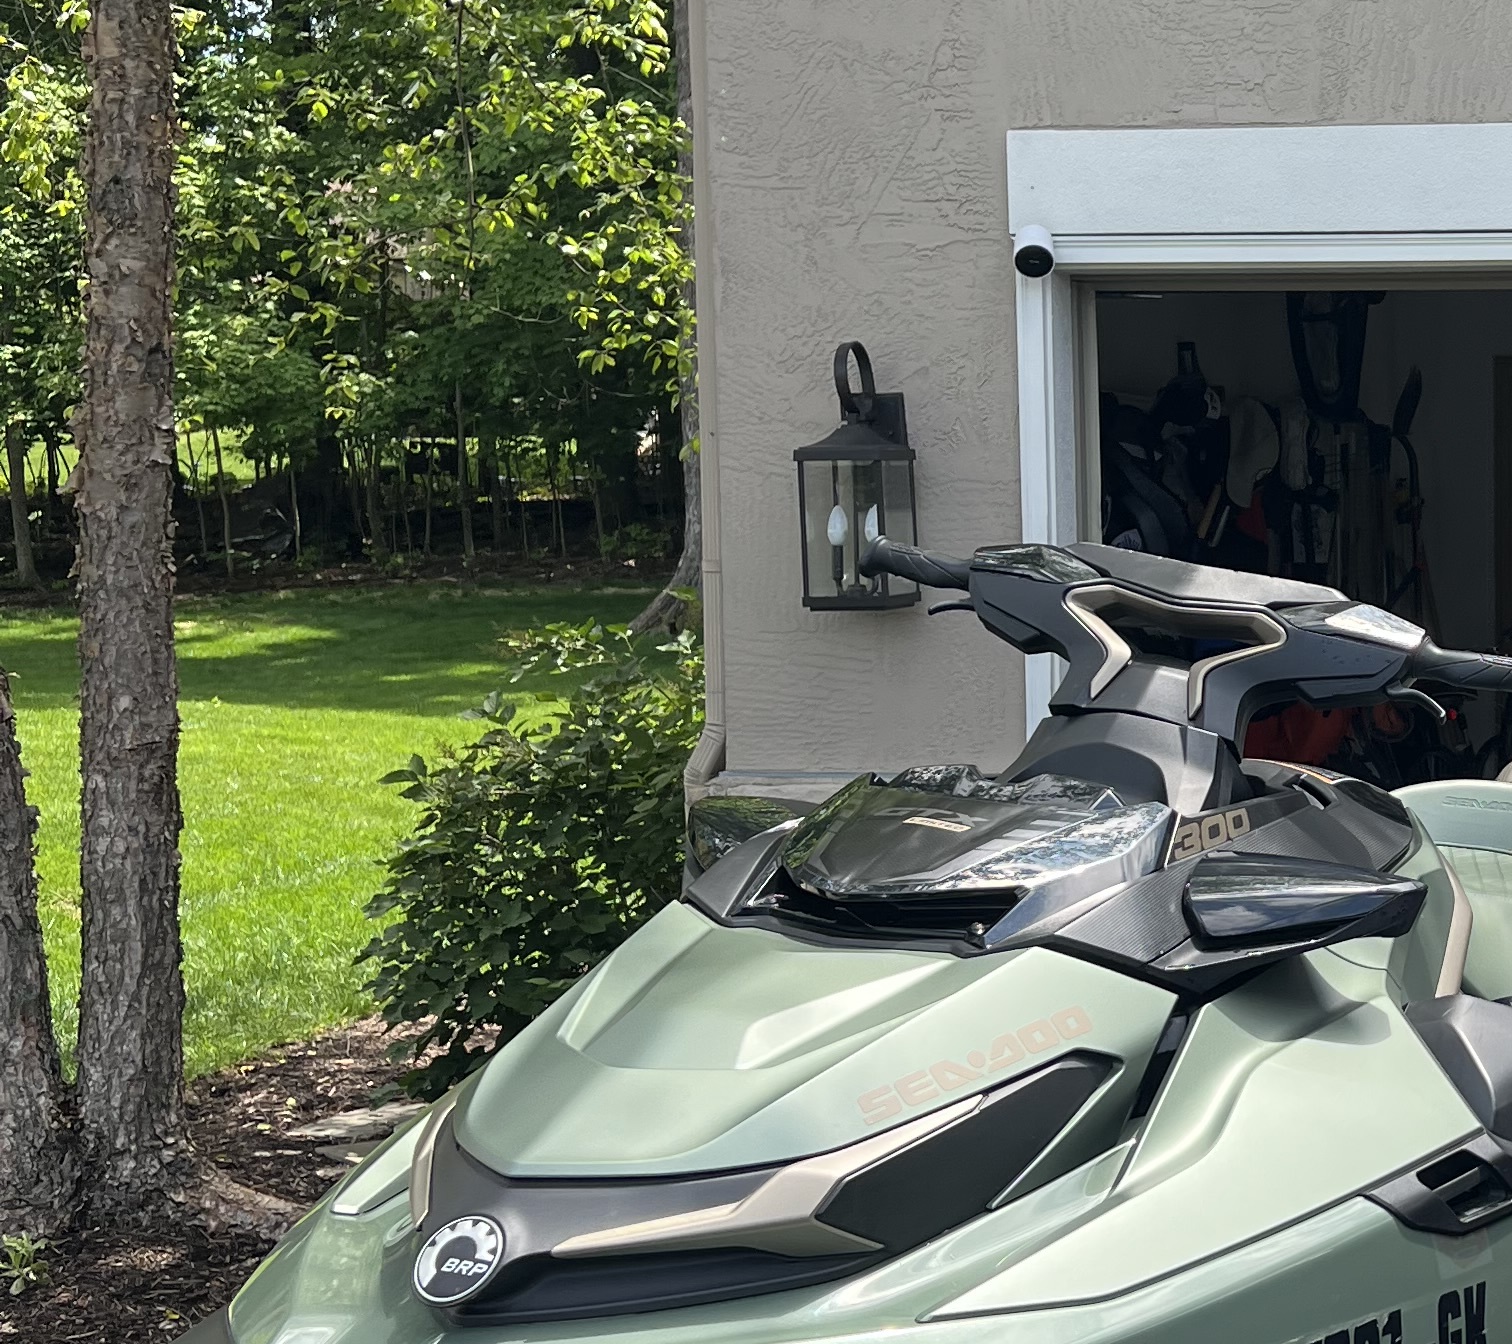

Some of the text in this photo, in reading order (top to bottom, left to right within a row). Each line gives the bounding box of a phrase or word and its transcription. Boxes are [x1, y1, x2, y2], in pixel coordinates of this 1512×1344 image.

[875, 807, 990, 827] GTX
[1174, 808, 1250, 860] 300
[440, 1258, 488, 1276] BRP
